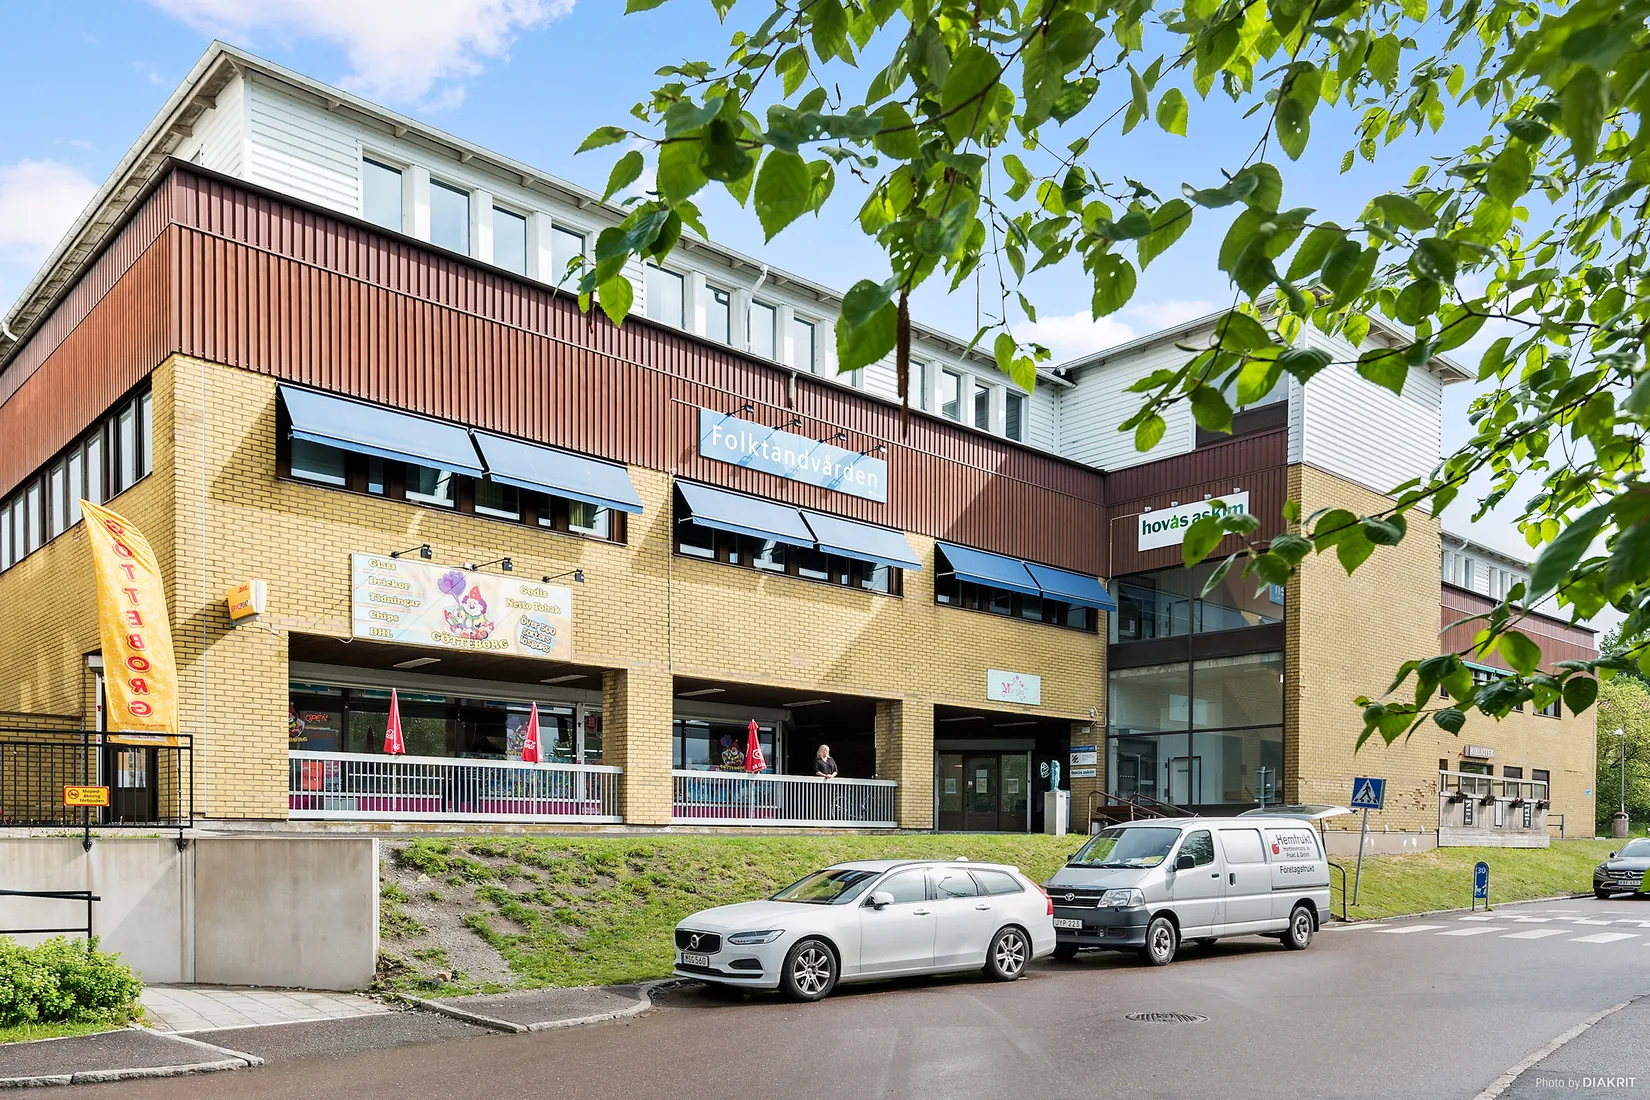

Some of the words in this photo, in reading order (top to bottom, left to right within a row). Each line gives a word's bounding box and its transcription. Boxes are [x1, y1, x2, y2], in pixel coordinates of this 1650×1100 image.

[711, 424, 878, 488] Folktandvården
[1142, 515, 1189, 535] hovås
[368, 559, 396, 570] Glass
[520, 585, 548, 598] Godis
[368, 593, 421, 608] Tidningar
[505, 598, 532, 611] Netto
[533, 602, 561, 614] Tobak
[368, 610, 399, 622] Chips
[520, 615, 540, 629] Över
[540, 623, 556, 636] 500
[368, 627, 393, 638] DHL
[522, 627, 552, 644] sorters
[431, 631, 509, 650] GÖTTEBORG
[305, 713, 328, 723] OPEN
[1470, 746, 1494, 757] BIBLIOTEK
[1276, 834, 1312, 845] Hemfrukt
[1280, 865, 1315, 874] Företagsfrukt
